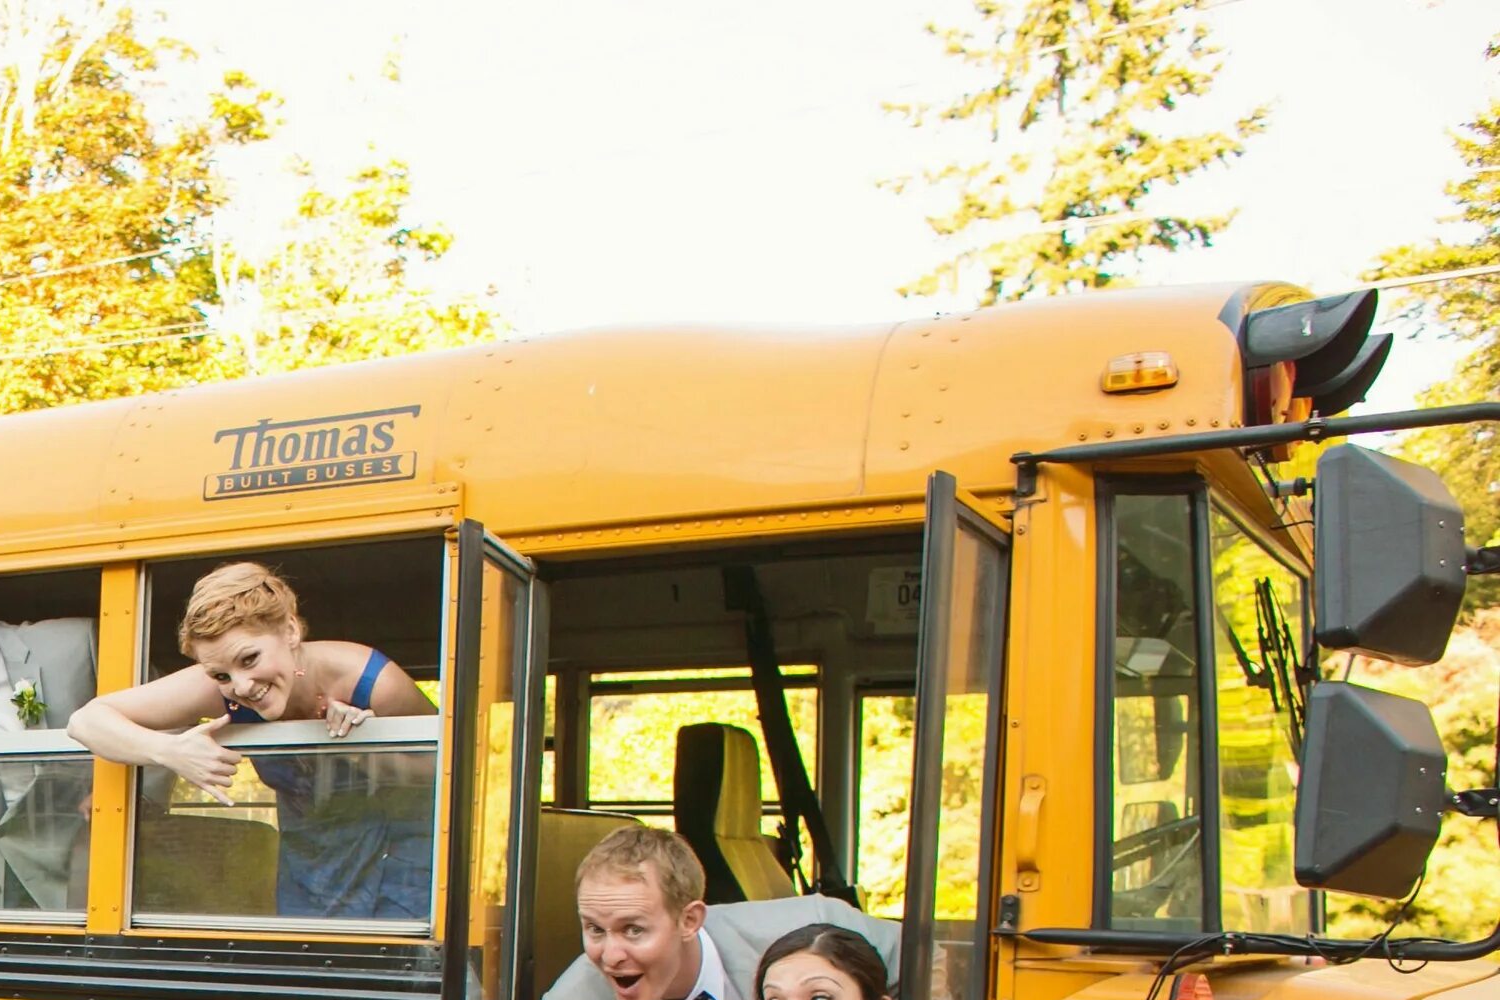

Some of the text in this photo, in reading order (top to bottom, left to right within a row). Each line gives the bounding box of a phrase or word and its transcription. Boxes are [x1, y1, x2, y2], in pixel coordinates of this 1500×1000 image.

[214, 404, 421, 470] Thomas
[224, 459, 393, 490] BUILT BUSES
